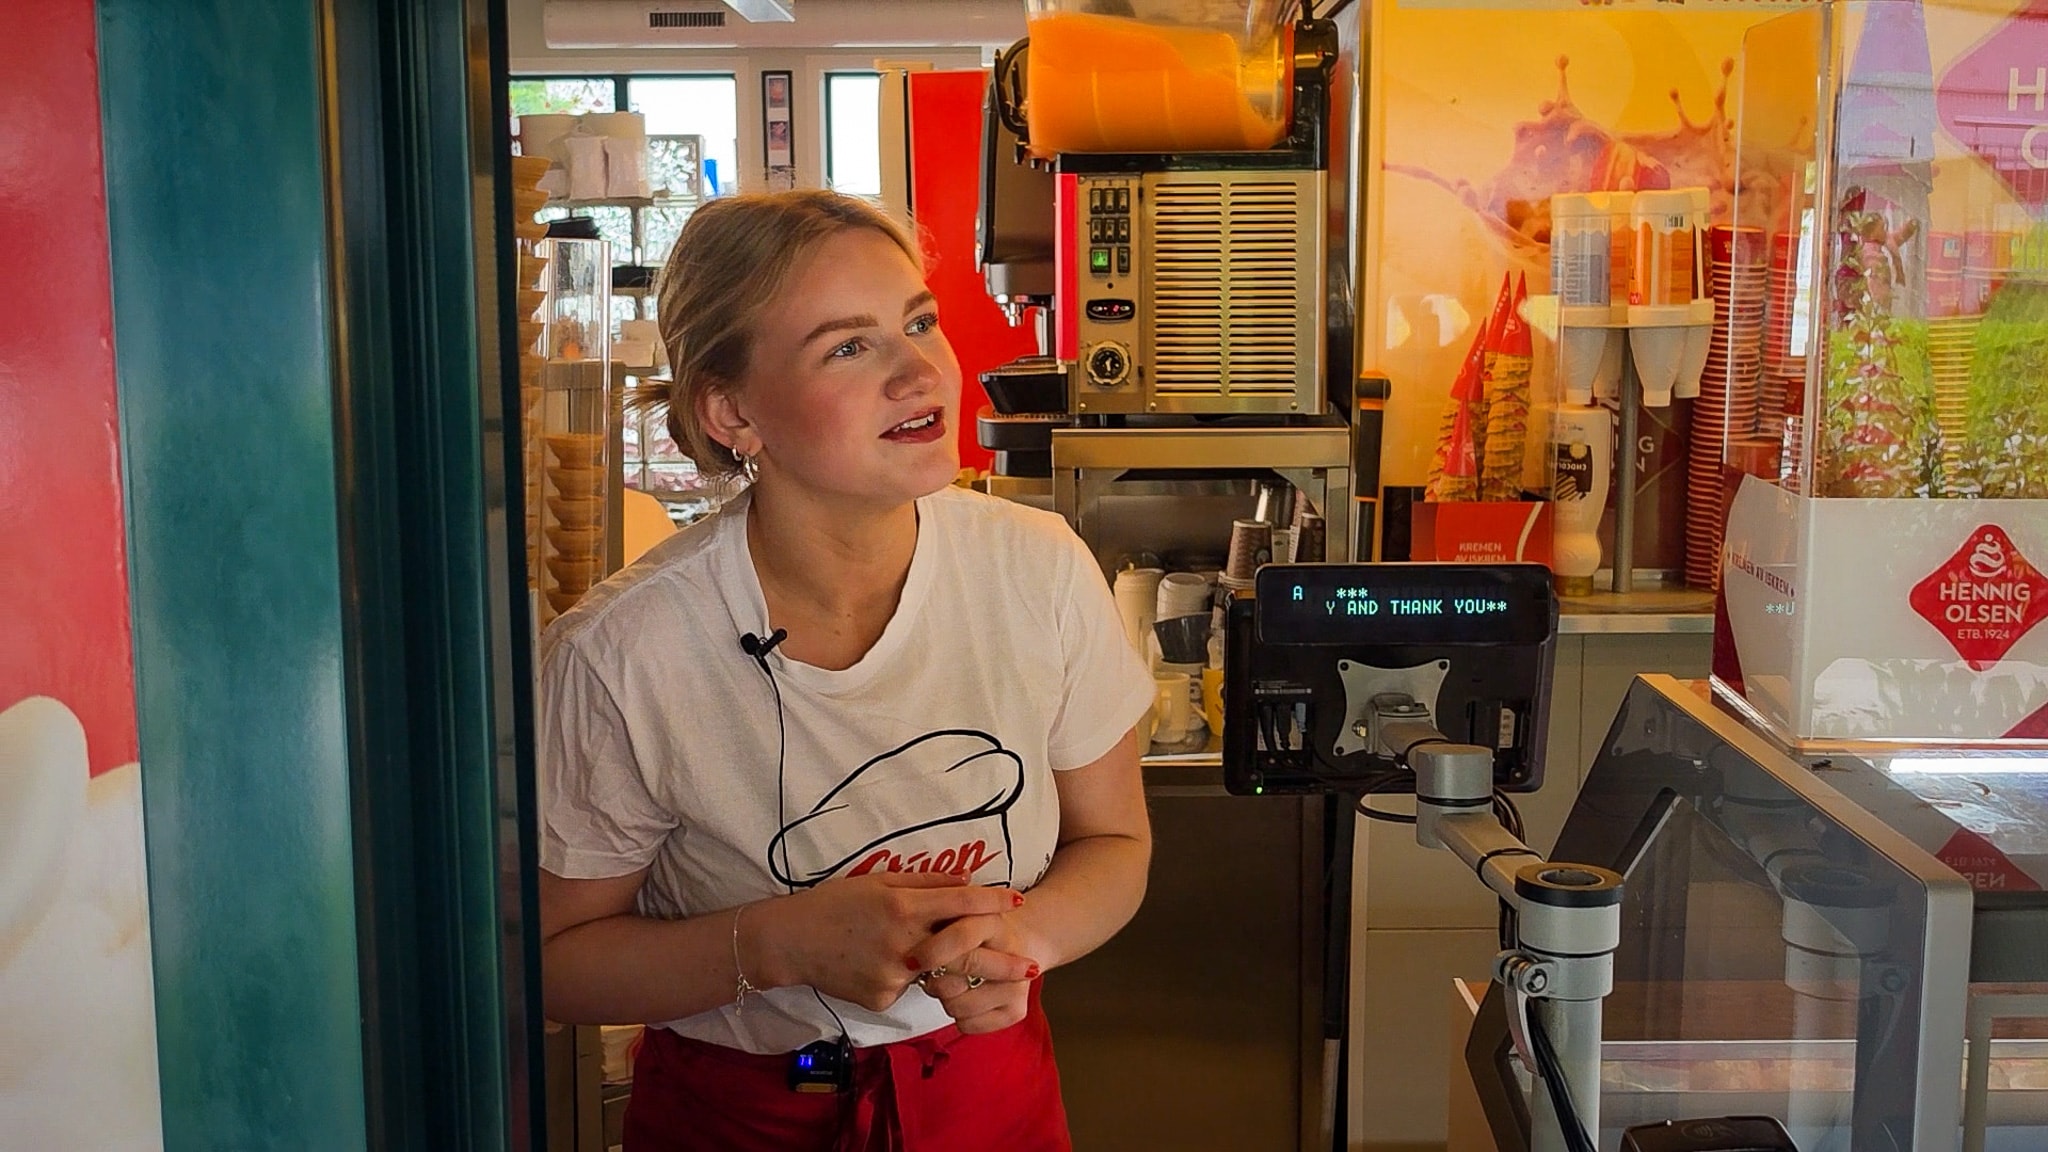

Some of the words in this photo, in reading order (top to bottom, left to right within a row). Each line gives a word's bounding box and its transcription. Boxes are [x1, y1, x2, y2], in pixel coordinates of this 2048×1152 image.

[1292, 585, 1304, 601] A
[1939, 582, 2031, 602] HENNIG
[1346, 600, 1379, 615] AND
[1389, 600, 1443, 615] THANK
[1945, 604, 2023, 623] OLSEN
